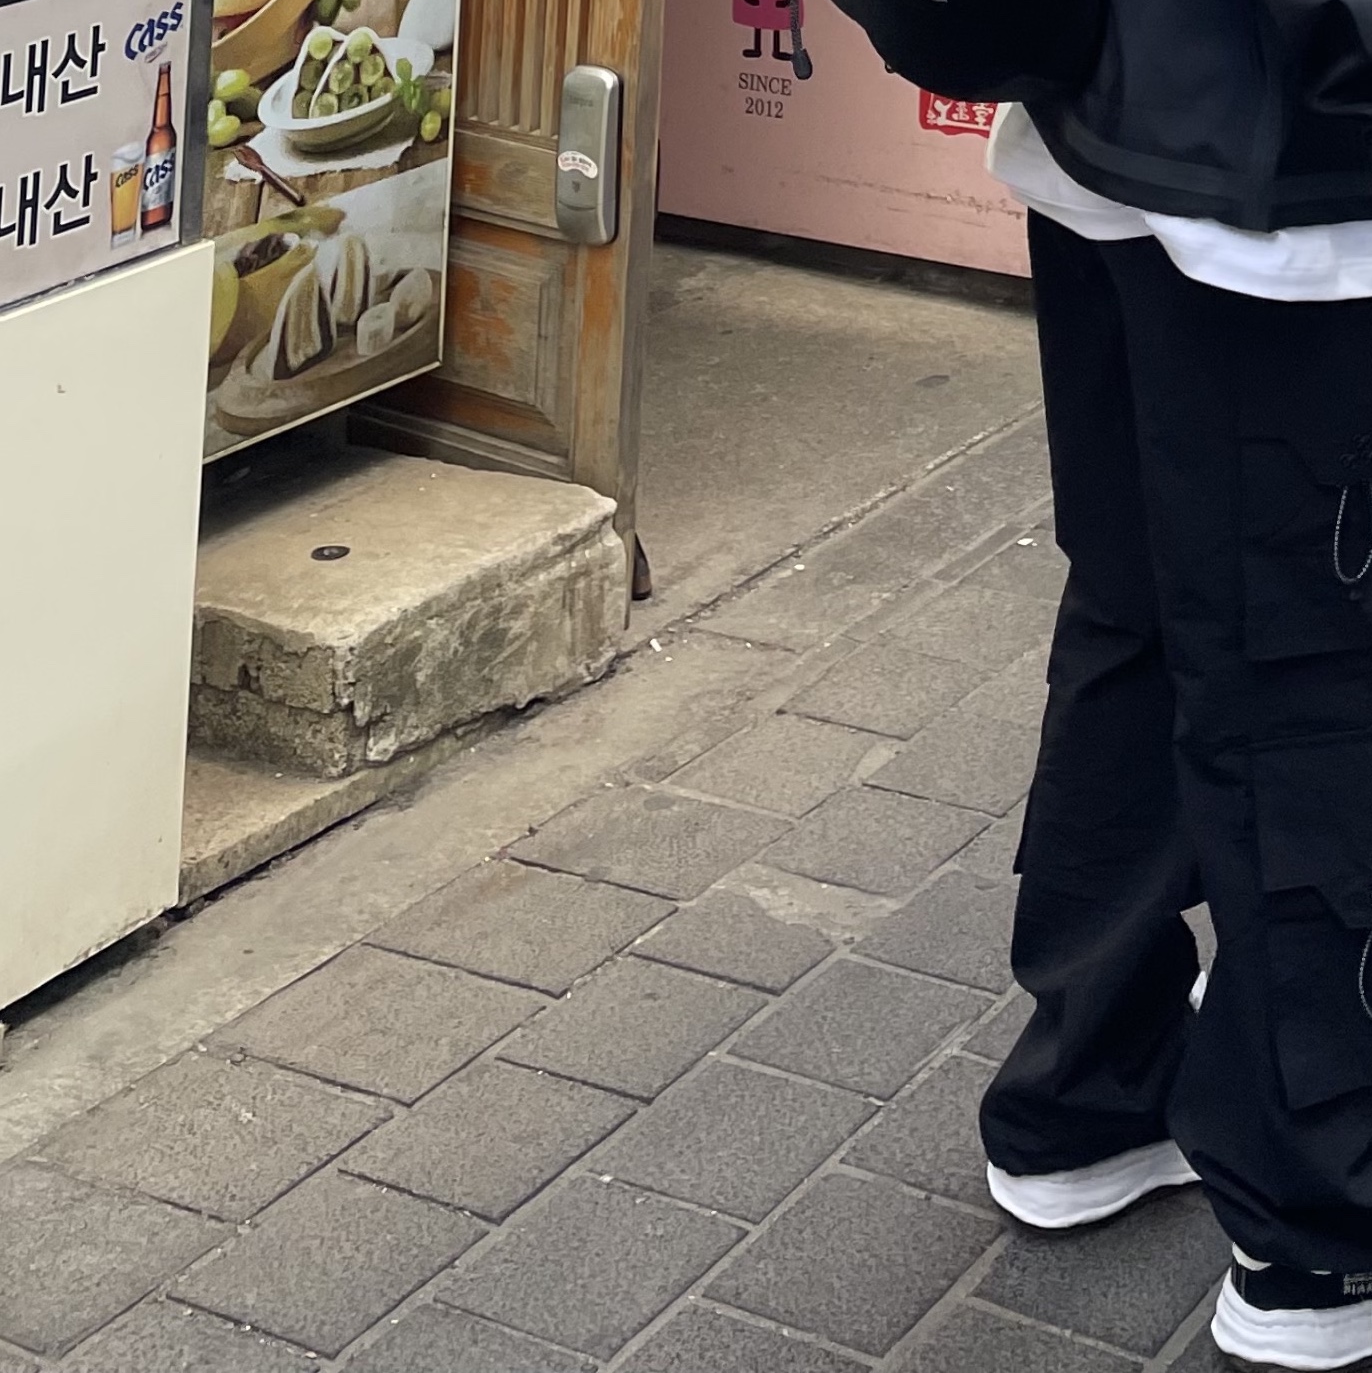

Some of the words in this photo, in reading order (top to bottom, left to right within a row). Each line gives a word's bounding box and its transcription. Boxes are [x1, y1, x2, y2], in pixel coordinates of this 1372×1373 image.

[0, 24, 106, 114] 내산
[738, 71, 792, 96] SINCE
[745, 96, 784, 119] 2012
